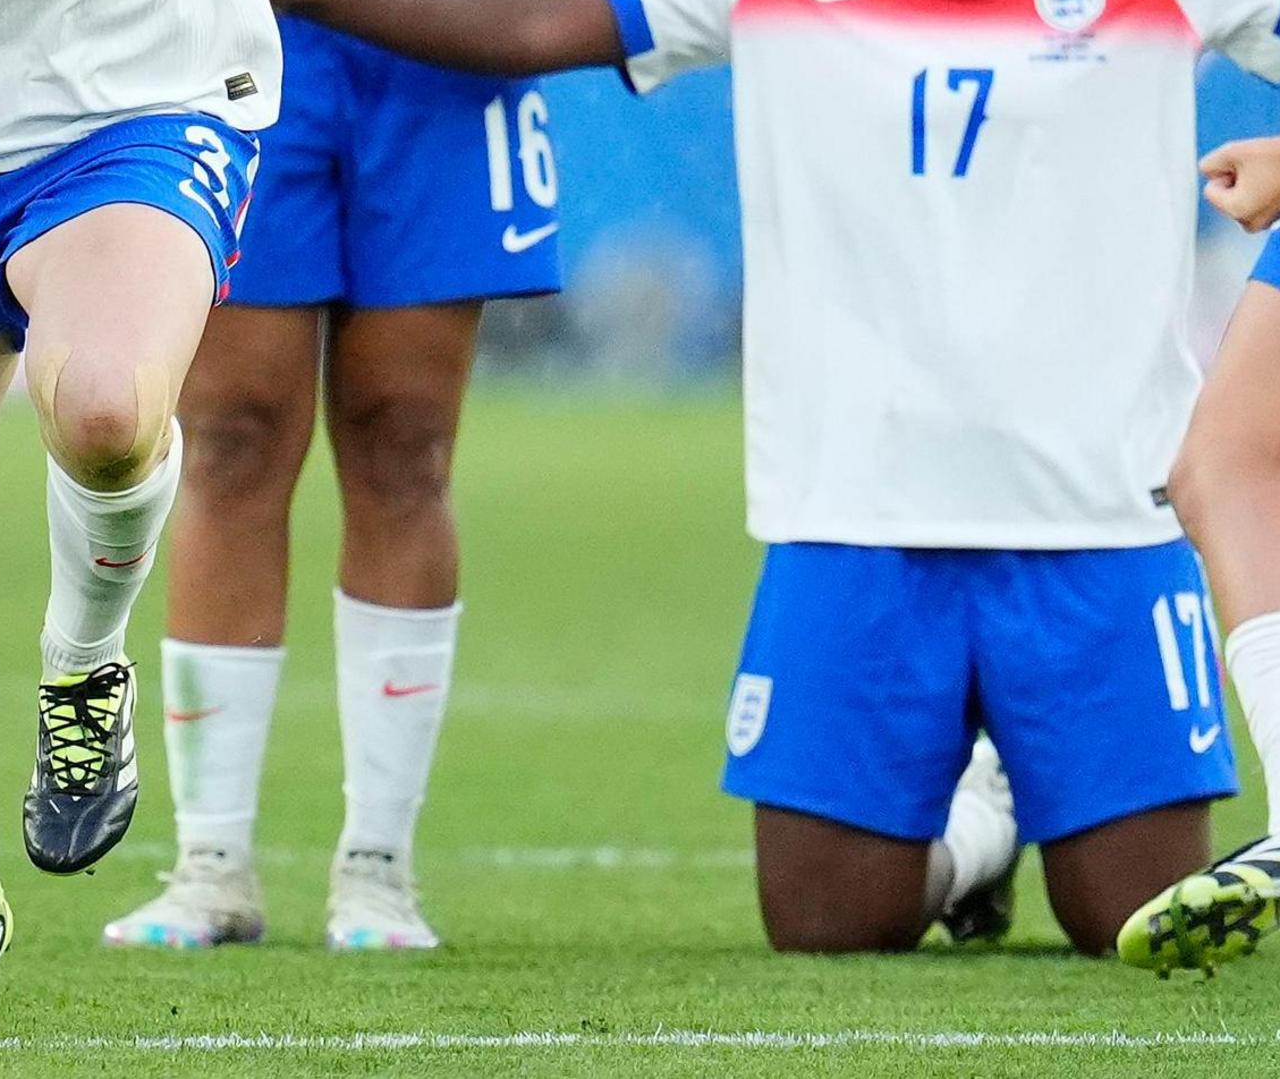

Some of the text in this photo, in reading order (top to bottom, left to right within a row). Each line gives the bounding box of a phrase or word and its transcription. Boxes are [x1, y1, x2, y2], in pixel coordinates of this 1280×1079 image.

[184, 125, 231, 210] 3
[484, 90, 559, 212] 16
[912, 68, 994, 177] 17
[1152, 592, 1211, 712] 17
